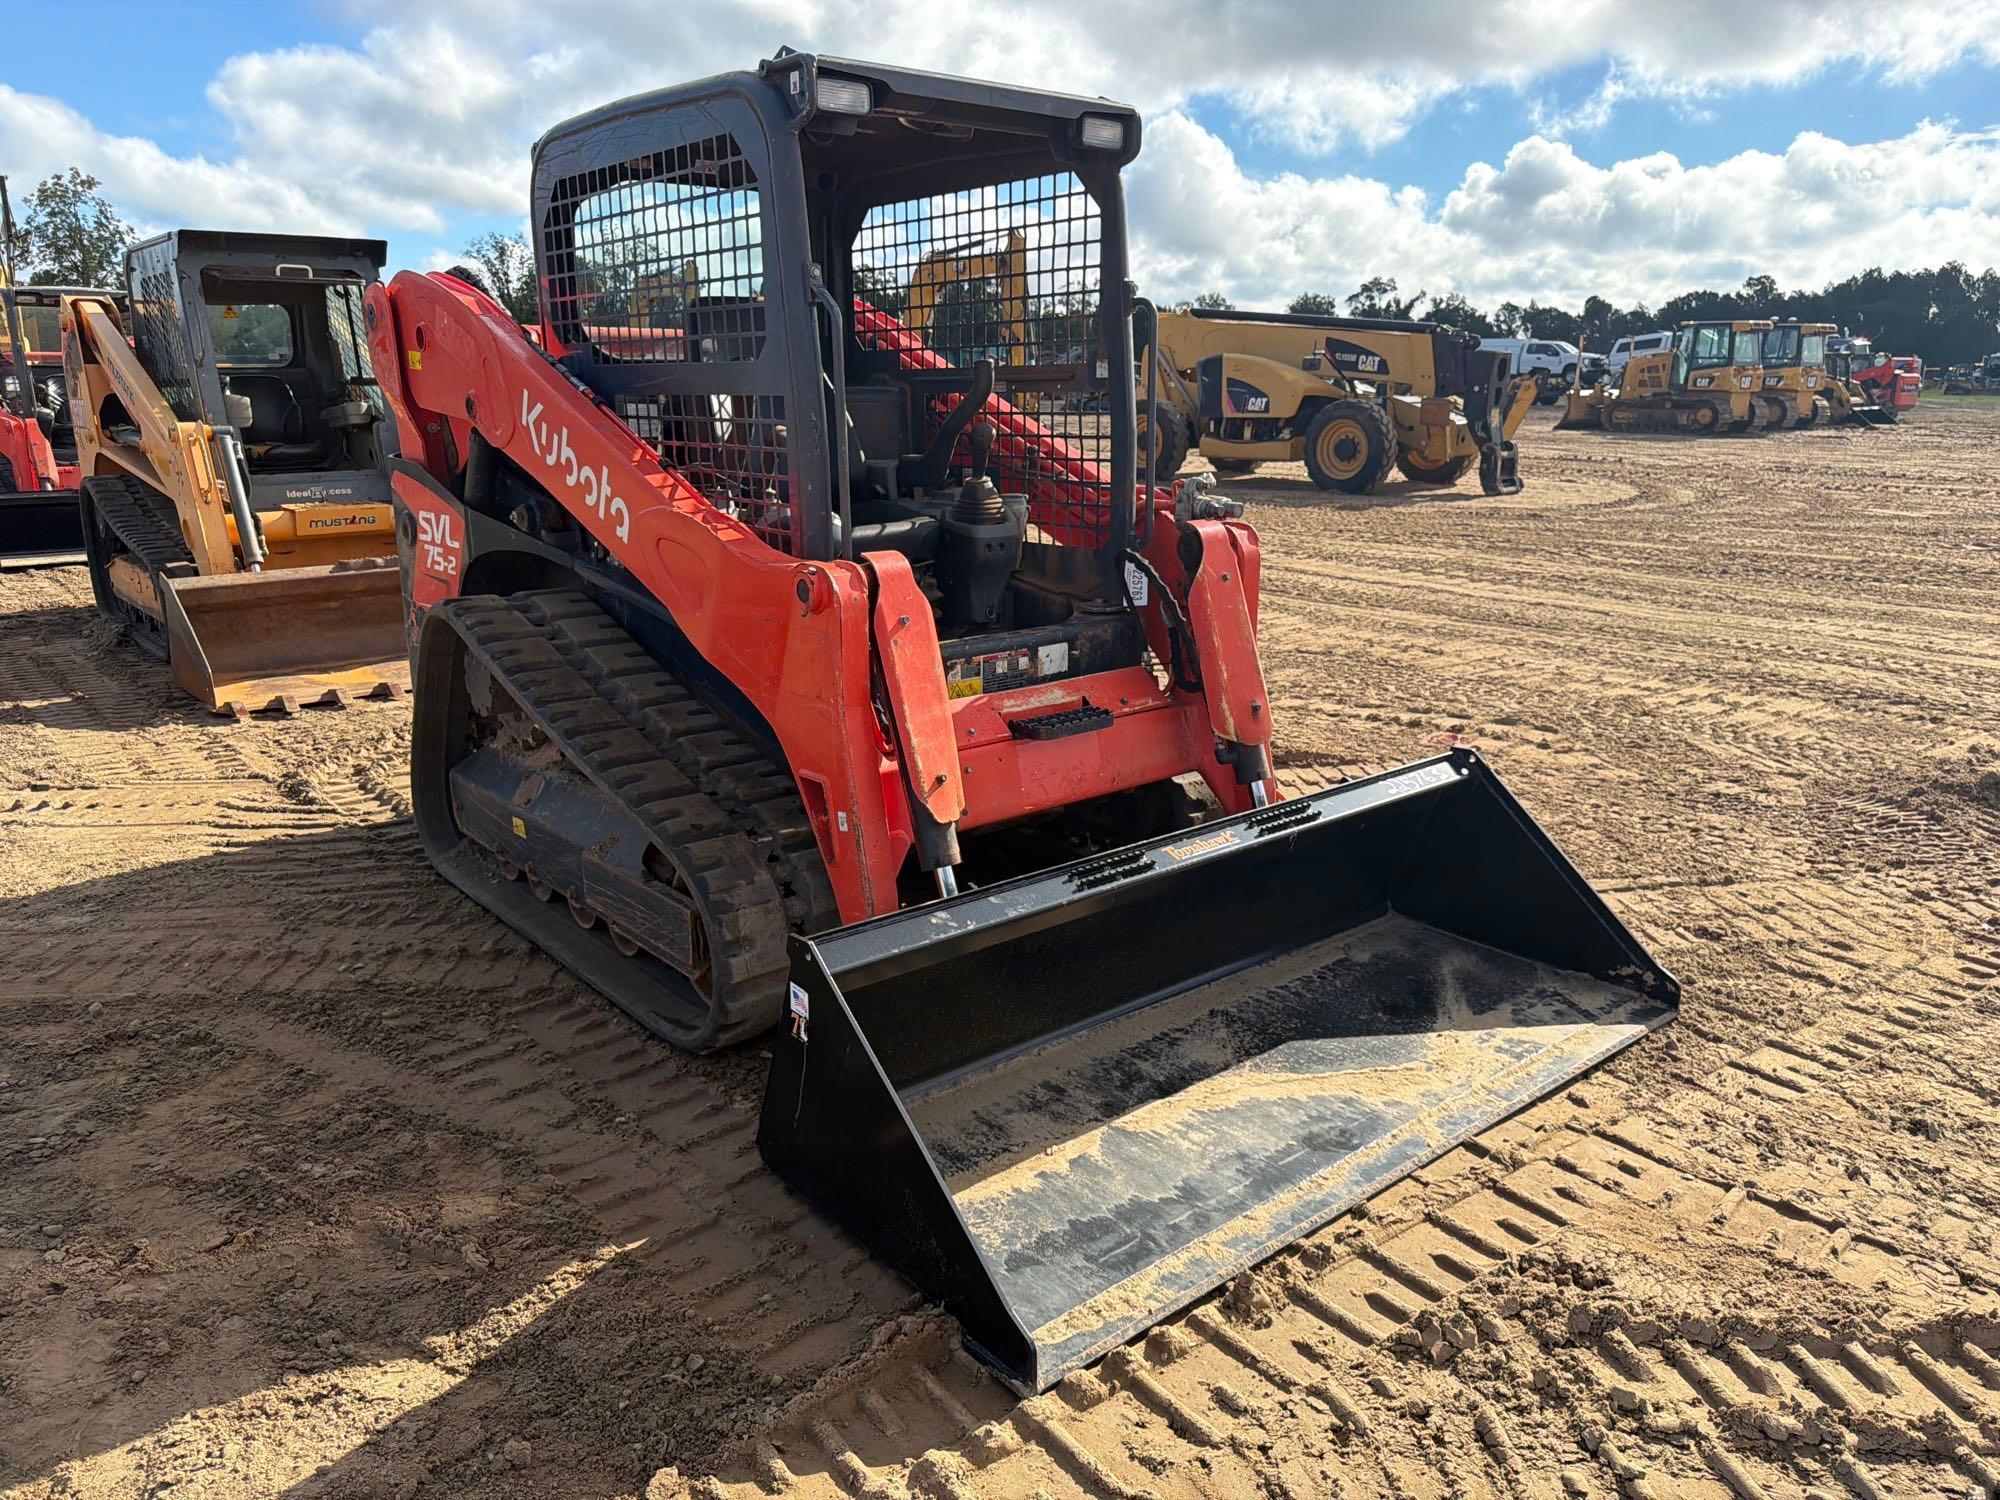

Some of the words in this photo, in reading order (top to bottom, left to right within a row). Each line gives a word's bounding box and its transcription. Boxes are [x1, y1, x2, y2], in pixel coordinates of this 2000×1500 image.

[1358, 355, 1381, 372] CAT
[1696, 378, 1709, 387] CAT
[1765, 377, 1778, 386] CAT
[1247, 397, 1268, 412] CAT
[521, 388, 630, 545] Kubota
[418, 510, 460, 549] SVL
[423, 543, 457, 575] 75-2
[1131, 569, 1143, 601] 225763
[1161, 828, 1236, 861] Tomahawk
